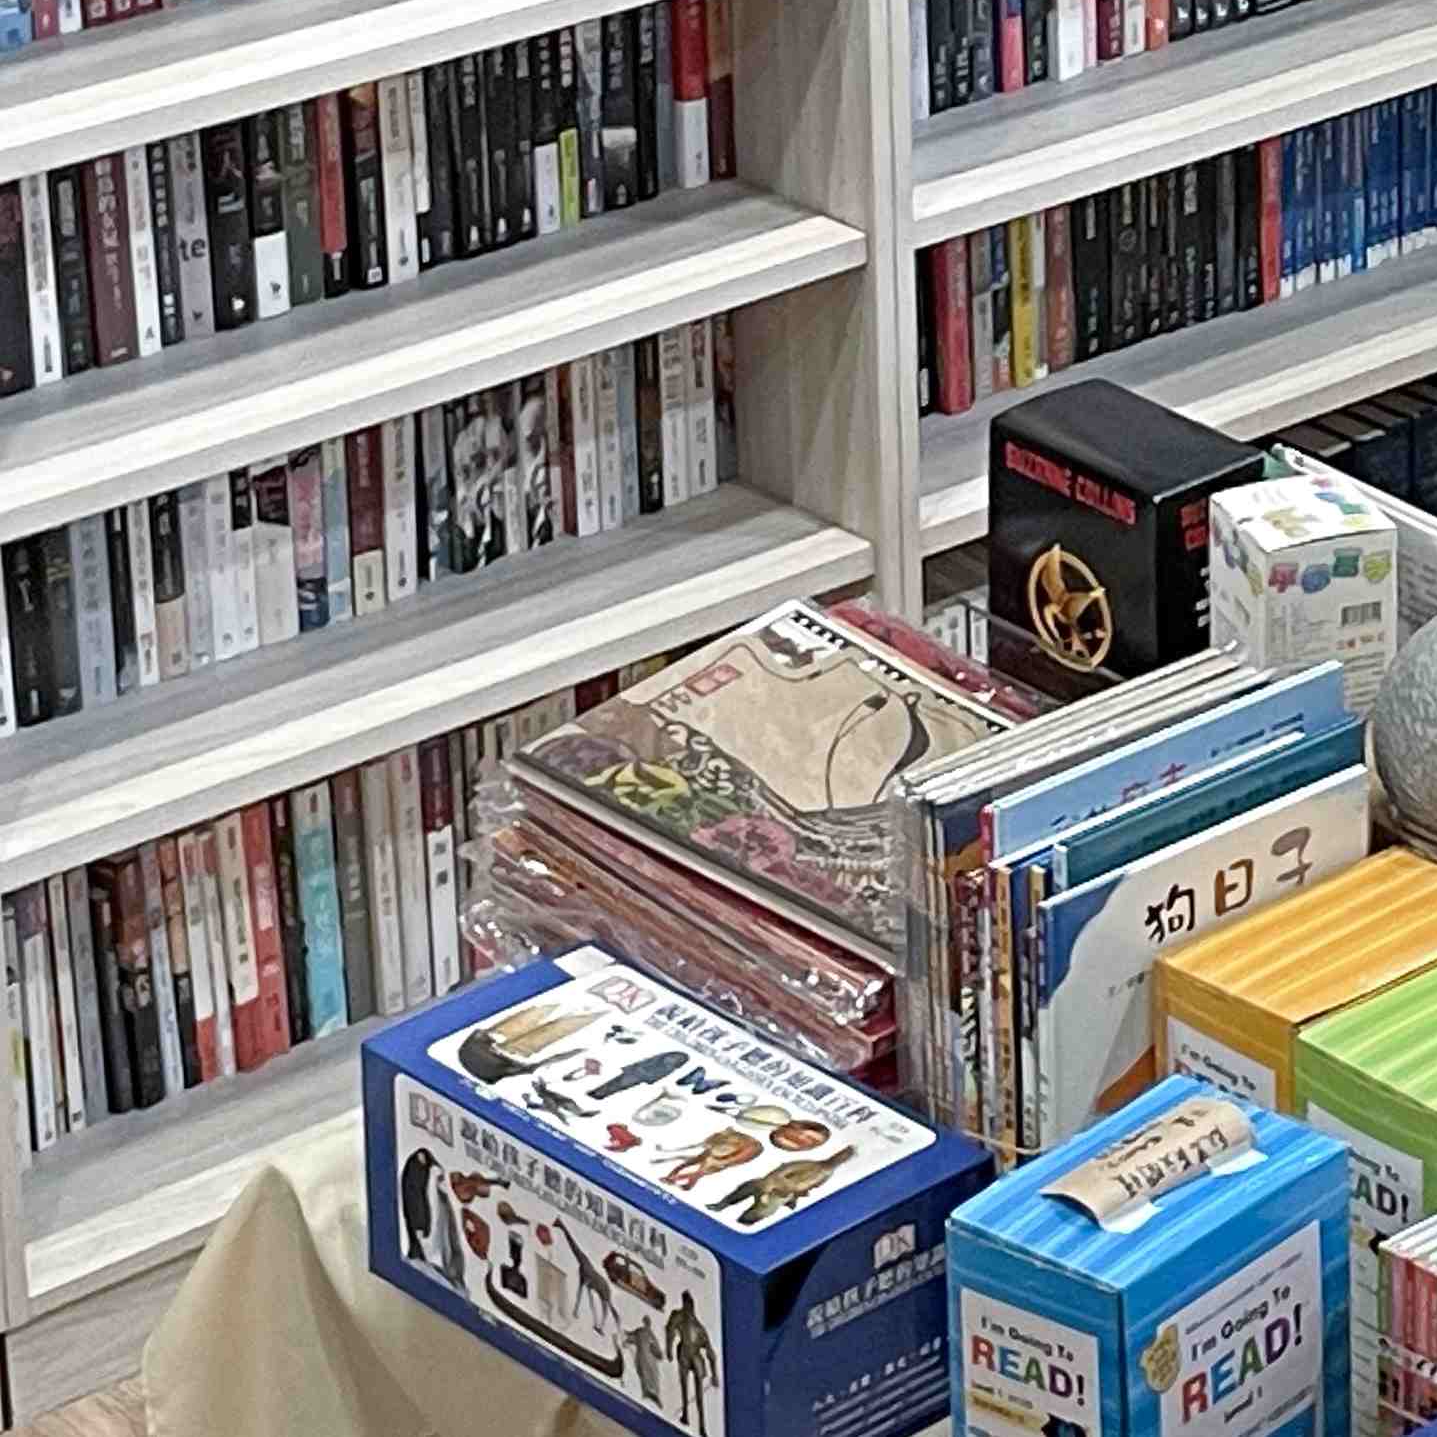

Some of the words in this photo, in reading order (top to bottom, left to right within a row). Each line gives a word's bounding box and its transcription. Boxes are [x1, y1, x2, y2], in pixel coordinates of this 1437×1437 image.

[179, 237, 207, 262] te
[1144, 825, 1313, 945] 狗日子
[1221, 1300, 1270, 1339] Going
[1272, 1285, 1292, 1305] To
[971, 1334, 1086, 1407] READ!
[1180, 1302, 1304, 1425] READ!
